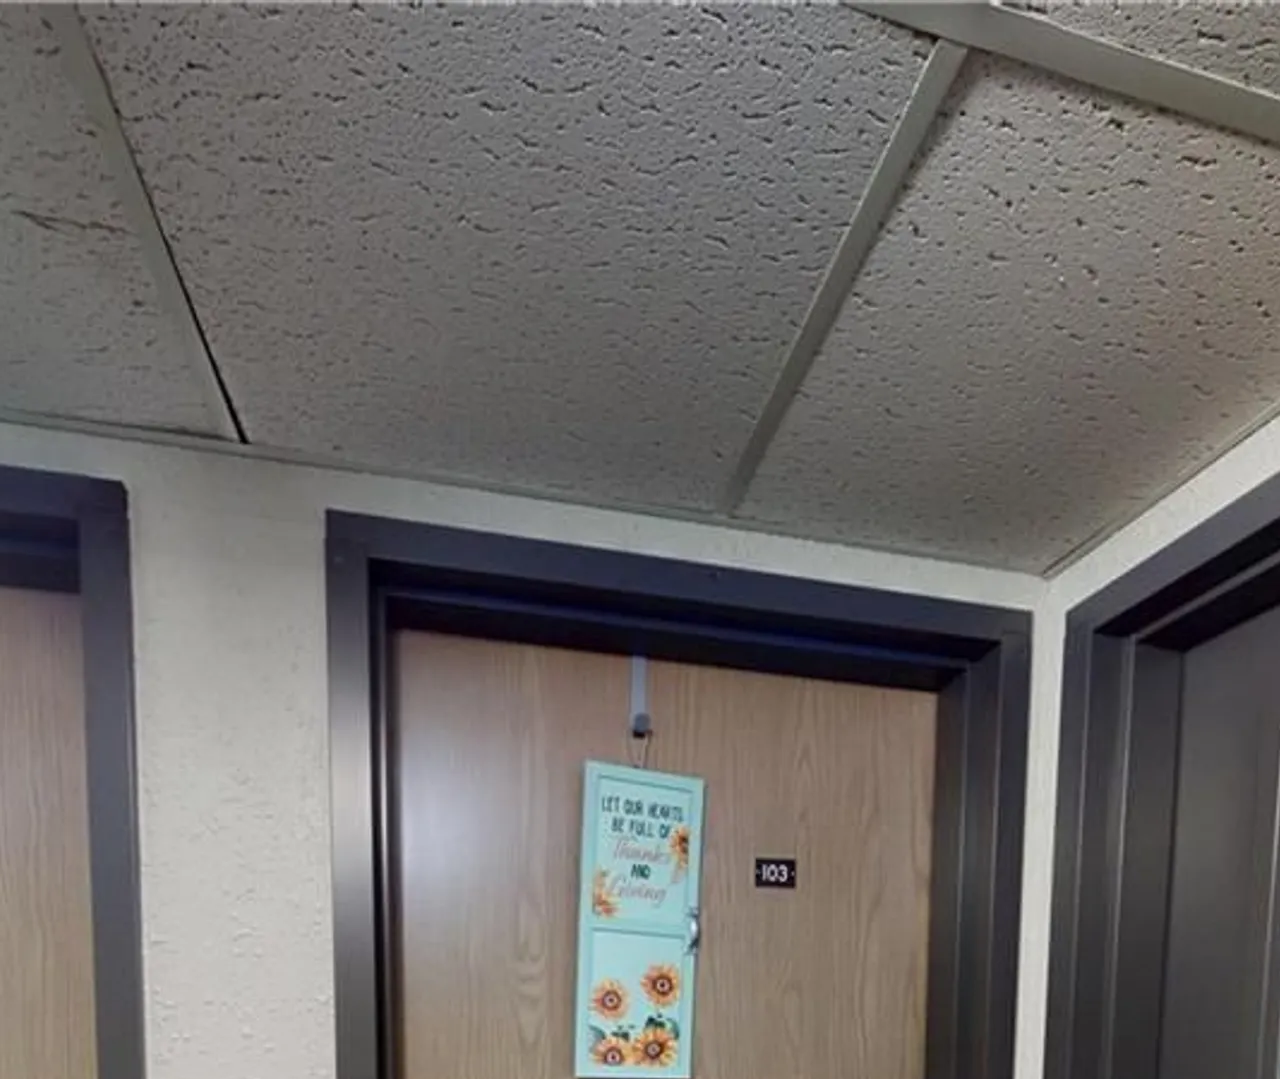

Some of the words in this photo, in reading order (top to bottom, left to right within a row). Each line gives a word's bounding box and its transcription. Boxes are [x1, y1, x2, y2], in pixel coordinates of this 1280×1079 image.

[601, 796, 620, 813] LET
[623, 798, 643, 816] OUR
[648, 802, 683, 822] HEARTS
[611, 817, 624, 833] BE
[629, 819, 654, 837] FULL
[659, 823, 671, 839] OF
[631, 863, 651, 880] AND
